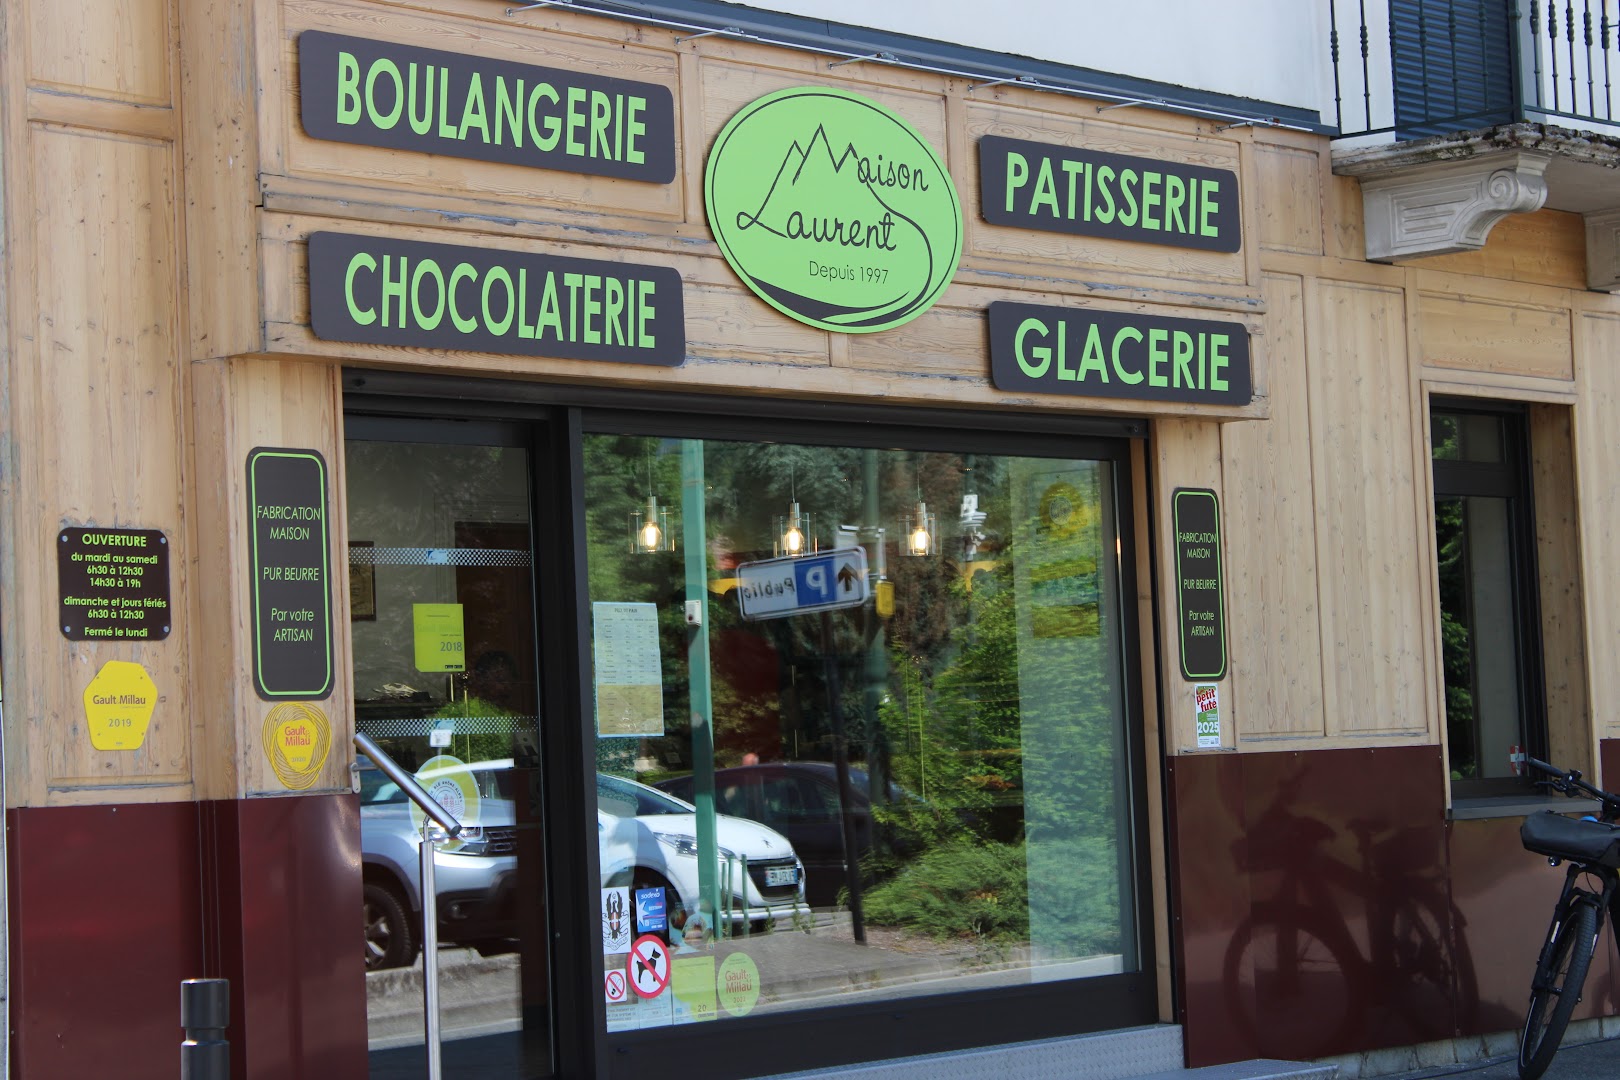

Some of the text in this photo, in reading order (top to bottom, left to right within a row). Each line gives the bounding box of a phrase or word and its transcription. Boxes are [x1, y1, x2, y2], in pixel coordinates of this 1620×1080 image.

[337, 51, 647, 164] BOULANGERIE
[793, 123, 928, 192] Maison
[1005, 152, 1220, 237] PATISSERIE
[737, 168, 897, 251] Laurent
[809, 260, 889, 284] Depuis 1997
[344, 252, 656, 349] CHOCOLATERIE
[1014, 317, 1230, 391] GLACERIE
[256, 505, 321, 520] FABRICATION
[269, 526, 310, 540] MAISON
[1179, 532, 1217, 543] FABRICATION
[82, 533, 147, 547] OUVERTURE
[71, 552, 158, 564] du mardi au samedi
[1186, 548, 1211, 558] MAISON
[86, 564, 144, 576] 6h30 à 12h30
[263, 567, 319, 581] PUR BEURRE
[90, 577, 141, 588] 14h30 à 19h
[1183, 578, 1217, 590] PUR BEURRE
[63, 596, 167, 609] dimanche et jours fériés
[87, 608, 145, 620] 6h30 à 12h30
[271, 607, 315, 622] Par votre
[1188, 610, 1215, 621] Par votre
[84, 626, 148, 637] Fermé le lundi
[273, 628, 313, 642] ARTISAN
[1190, 625, 1215, 636] ARTISAN
[440, 641, 463, 652] 2018
[92, 694, 146, 705] Gault Millau
[1196, 688, 1216, 705] petit
[108, 718, 132, 727] 2019
[1197, 721, 1219, 733] 2025
[284, 725, 306, 736] Gault
[285, 735, 311, 746] Millau
[725, 968, 747, 981] Gault
[725, 979, 752, 994] Millau
